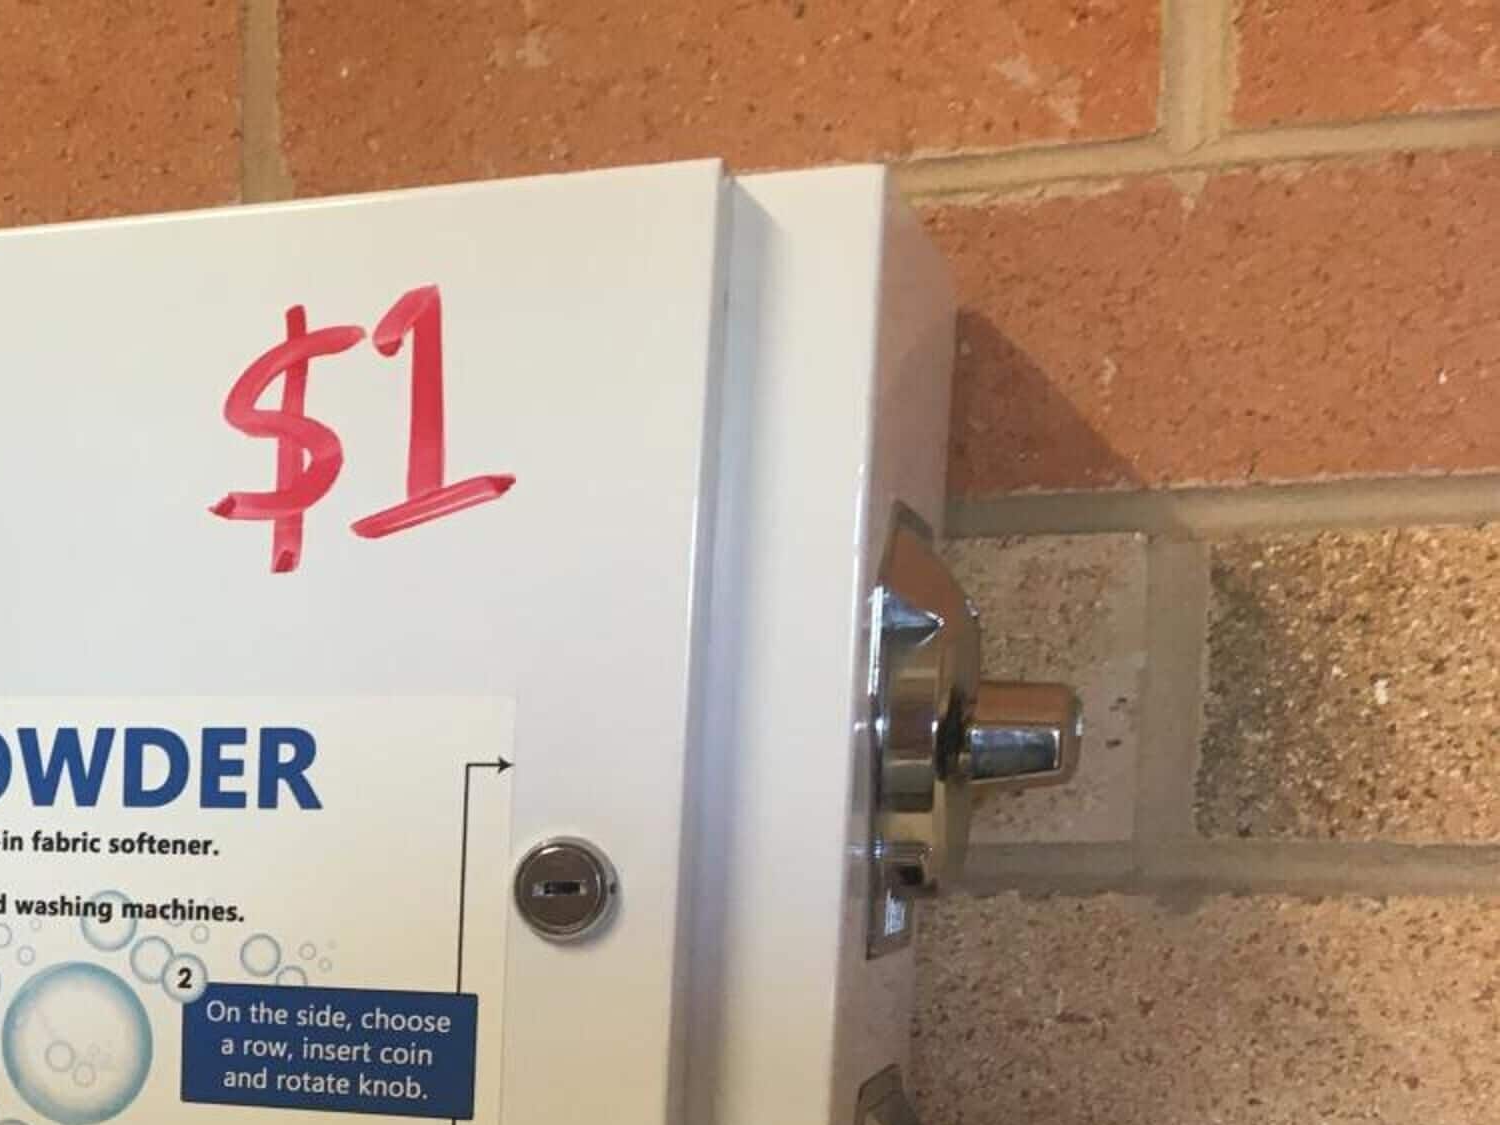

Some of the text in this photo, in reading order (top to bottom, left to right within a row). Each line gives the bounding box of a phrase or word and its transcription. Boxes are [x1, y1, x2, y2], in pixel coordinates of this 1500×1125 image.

[207, 283, 517, 574] $1
[32, 831, 101, 853] fabric
[108, 832, 220, 856] softener.
[15, 895, 113, 924] washing
[121, 899, 245, 923] machines.
[177, 968, 192, 989] 2
[206, 1000, 452, 1033] On the side, choose
[221, 1037, 433, 1066] a row, insert coin
[223, 1068, 429, 1100] and rotate knob.
